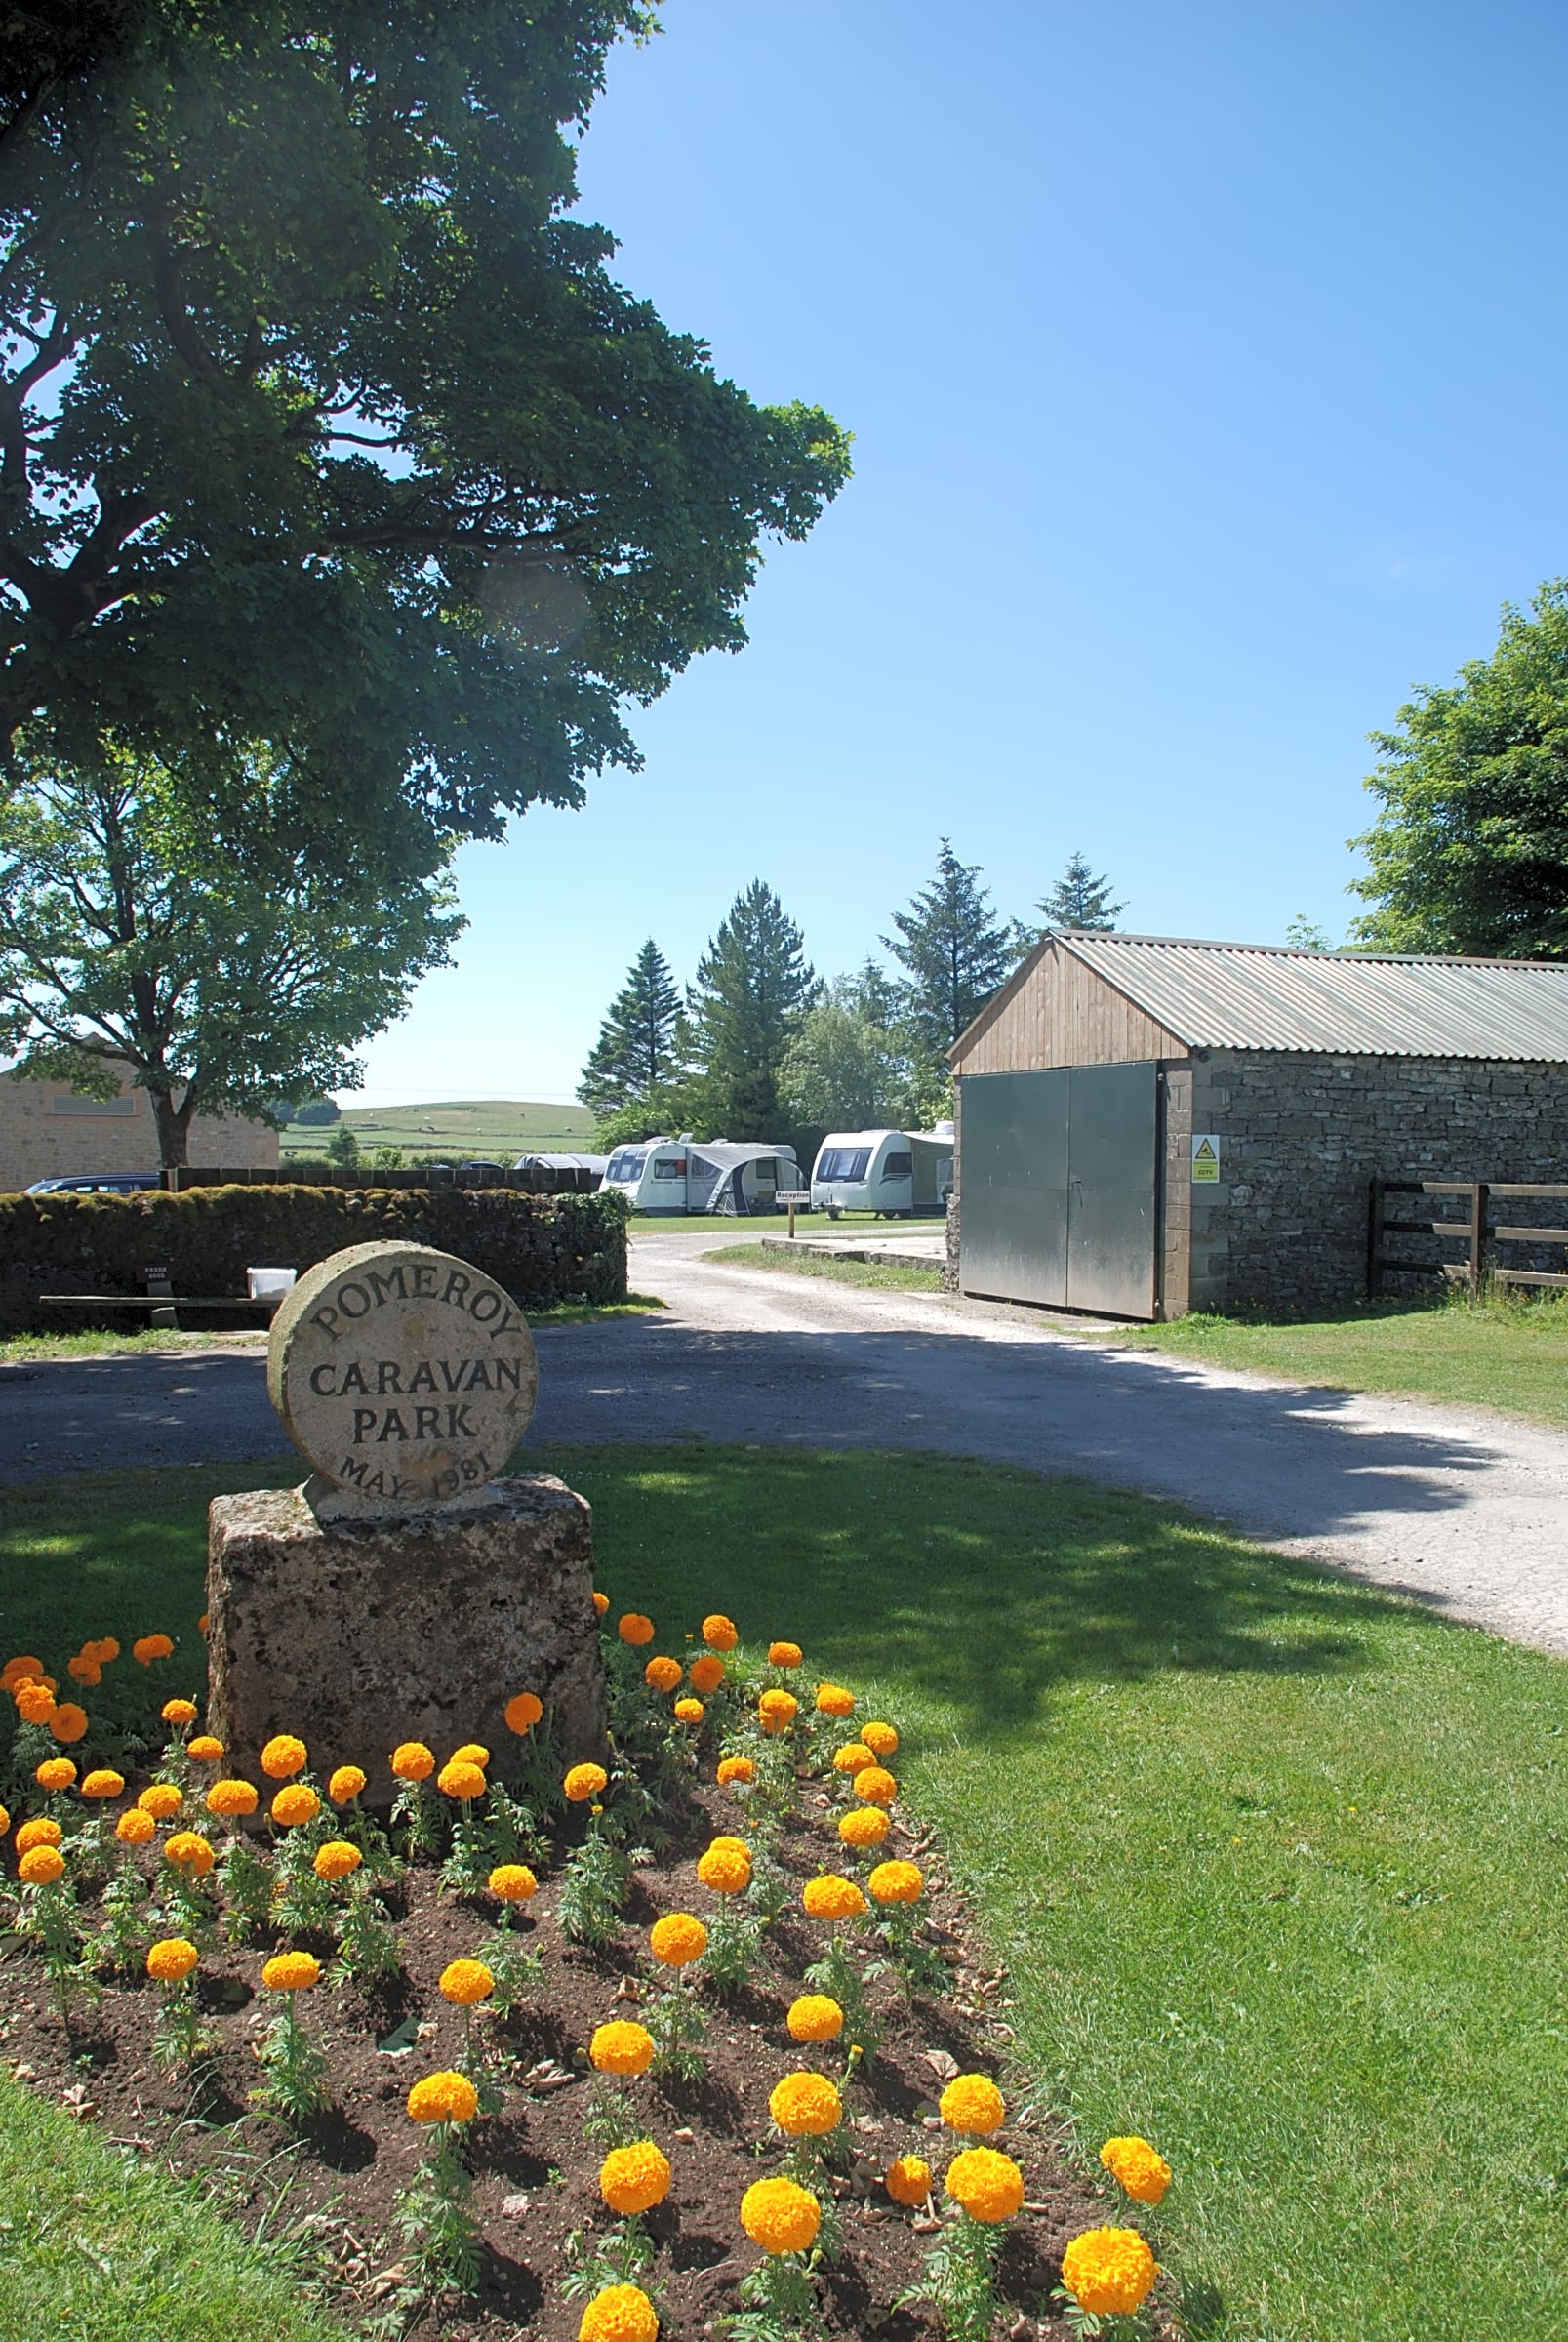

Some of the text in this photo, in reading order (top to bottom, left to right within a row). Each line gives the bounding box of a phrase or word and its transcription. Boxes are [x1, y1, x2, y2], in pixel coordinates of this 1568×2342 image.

[309, 1264, 522, 1342] POMEROY
[309, 1357, 522, 1396] CARAVAN
[351, 1403, 477, 1444] PARK
[337, 1451, 492, 1500] MAY 1981
